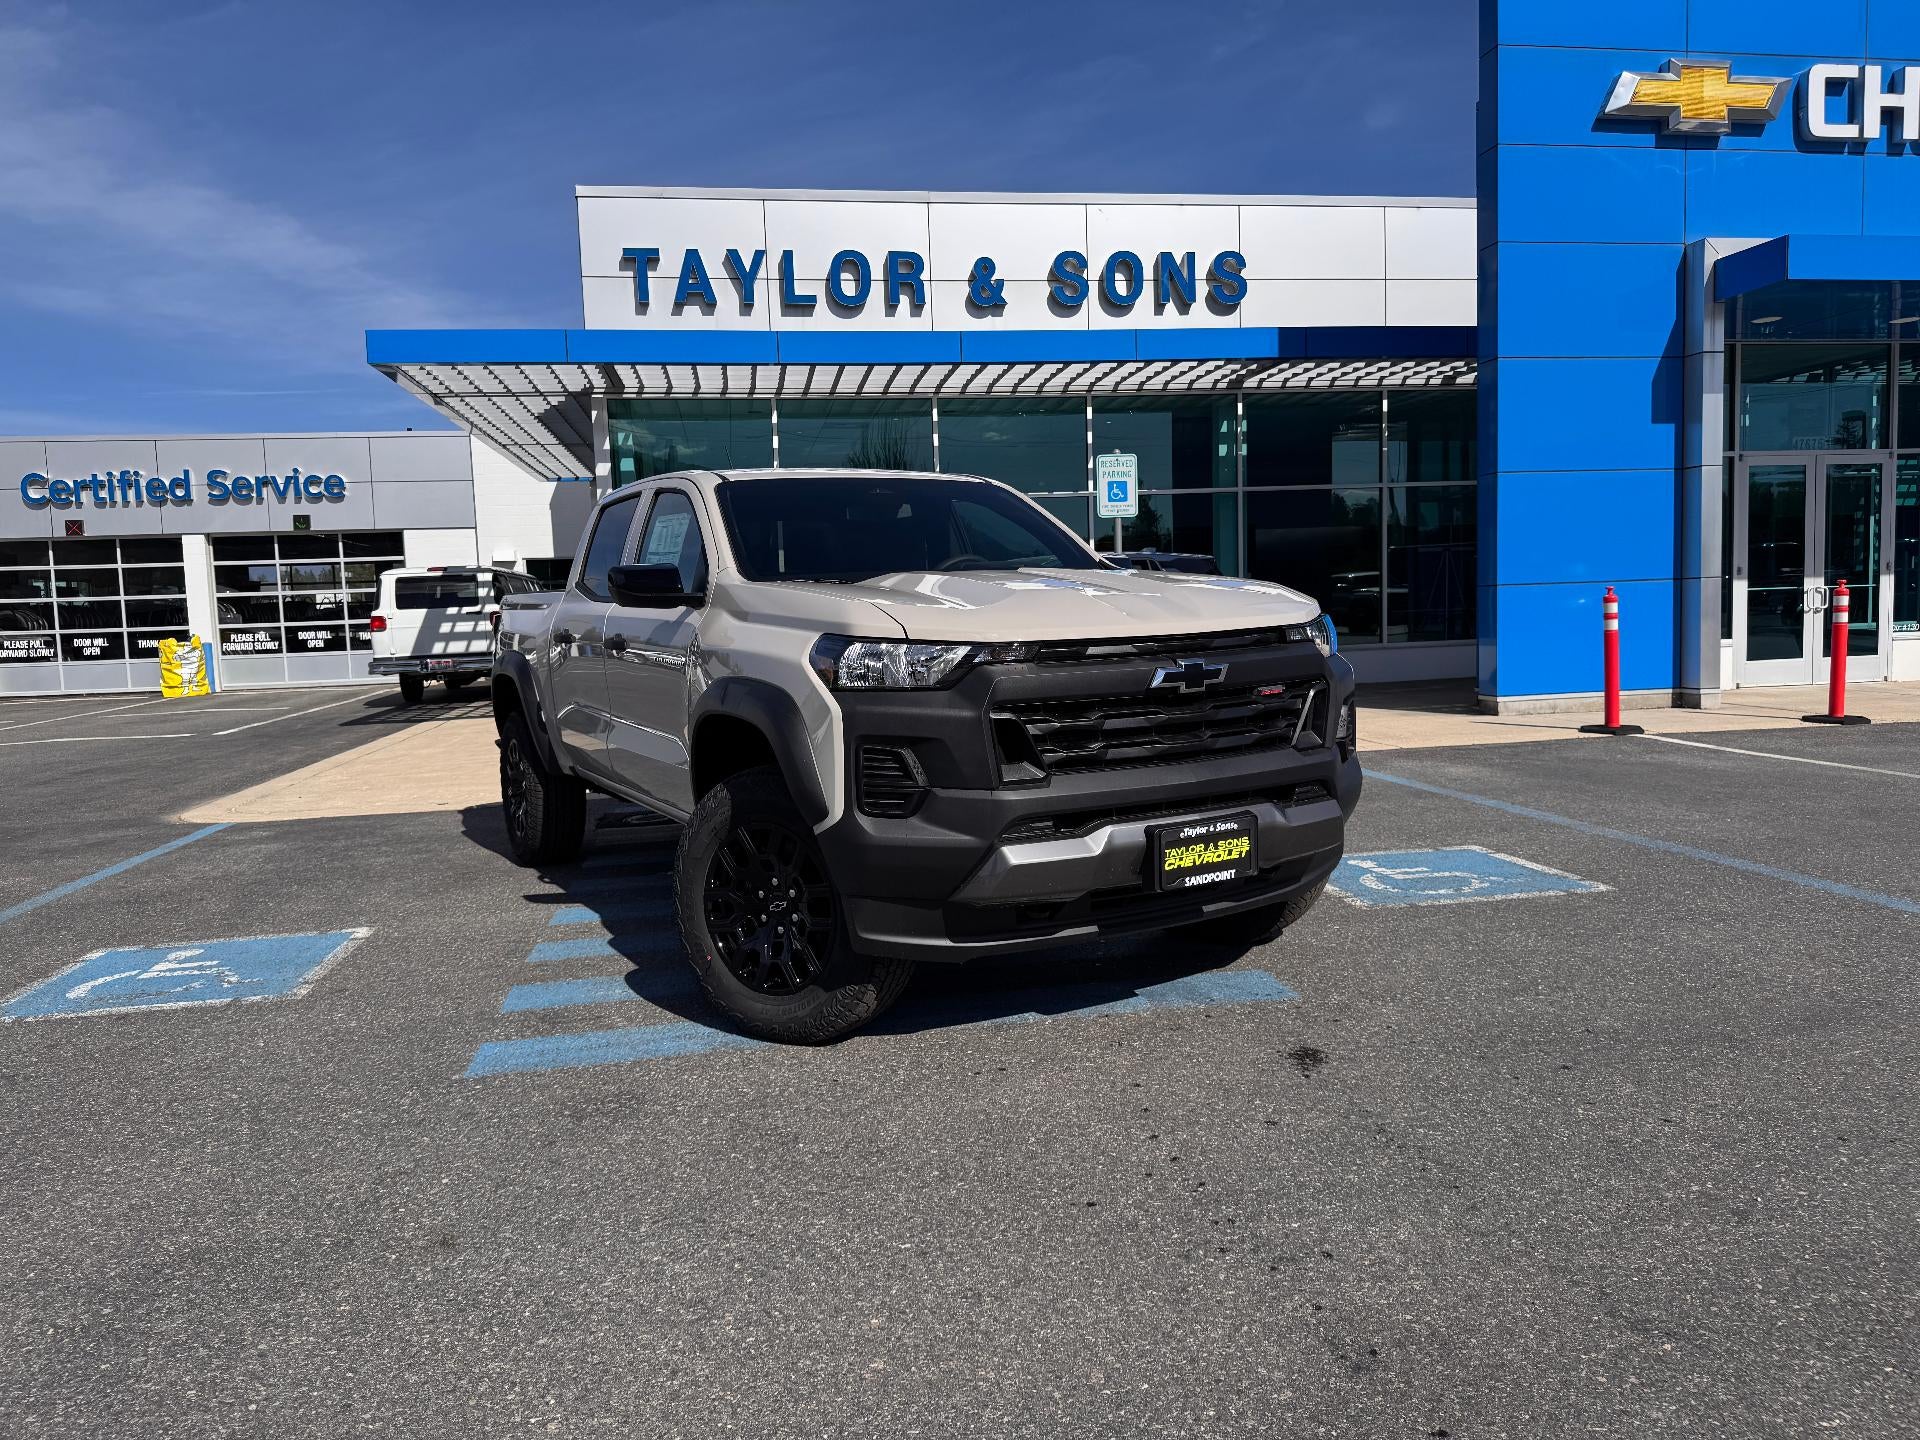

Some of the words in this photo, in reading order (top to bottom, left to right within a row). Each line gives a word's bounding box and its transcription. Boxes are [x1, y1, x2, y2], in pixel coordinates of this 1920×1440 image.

[622, 247, 926, 306] TAYLOR
[970, 257, 1008, 306] &
[1053, 250, 1248, 305] SONS
[1101, 460, 1134, 468] RESERVED
[20, 469, 193, 504] Certified
[207, 467, 345, 500] Service
[230, 633, 254, 642] PLEASE
[254, 632, 271, 641] PULL
[298, 631, 315, 639] DOOR
[317, 630, 332, 639] WILL
[359, 631, 371, 640] THA
[4, 640, 28, 649] PLEASE
[29, 639, 46, 648] PULL
[73, 638, 91, 647] DOOR
[93, 637, 109, 646] WILL
[223, 642, 253, 651] FORWARD
[254, 641, 279, 650] SLOWLY
[307, 639, 324, 648] OPEN
[0, 649, 28, 657] ORWARD
[29, 648, 54, 657] SLOWLY
[83, 647, 100, 655] OPEN
[1184, 826, 1207, 838] Taylor
[1216, 822, 1235, 832] Sons
[1165, 843, 1204, 858] TAYLOR
[1208, 843, 1215, 852] &
[1218, 837, 1250, 849] SONS
[1164, 847, 1250, 870] CHEVROLET
[1185, 869, 1236, 886] SANDPOINT
